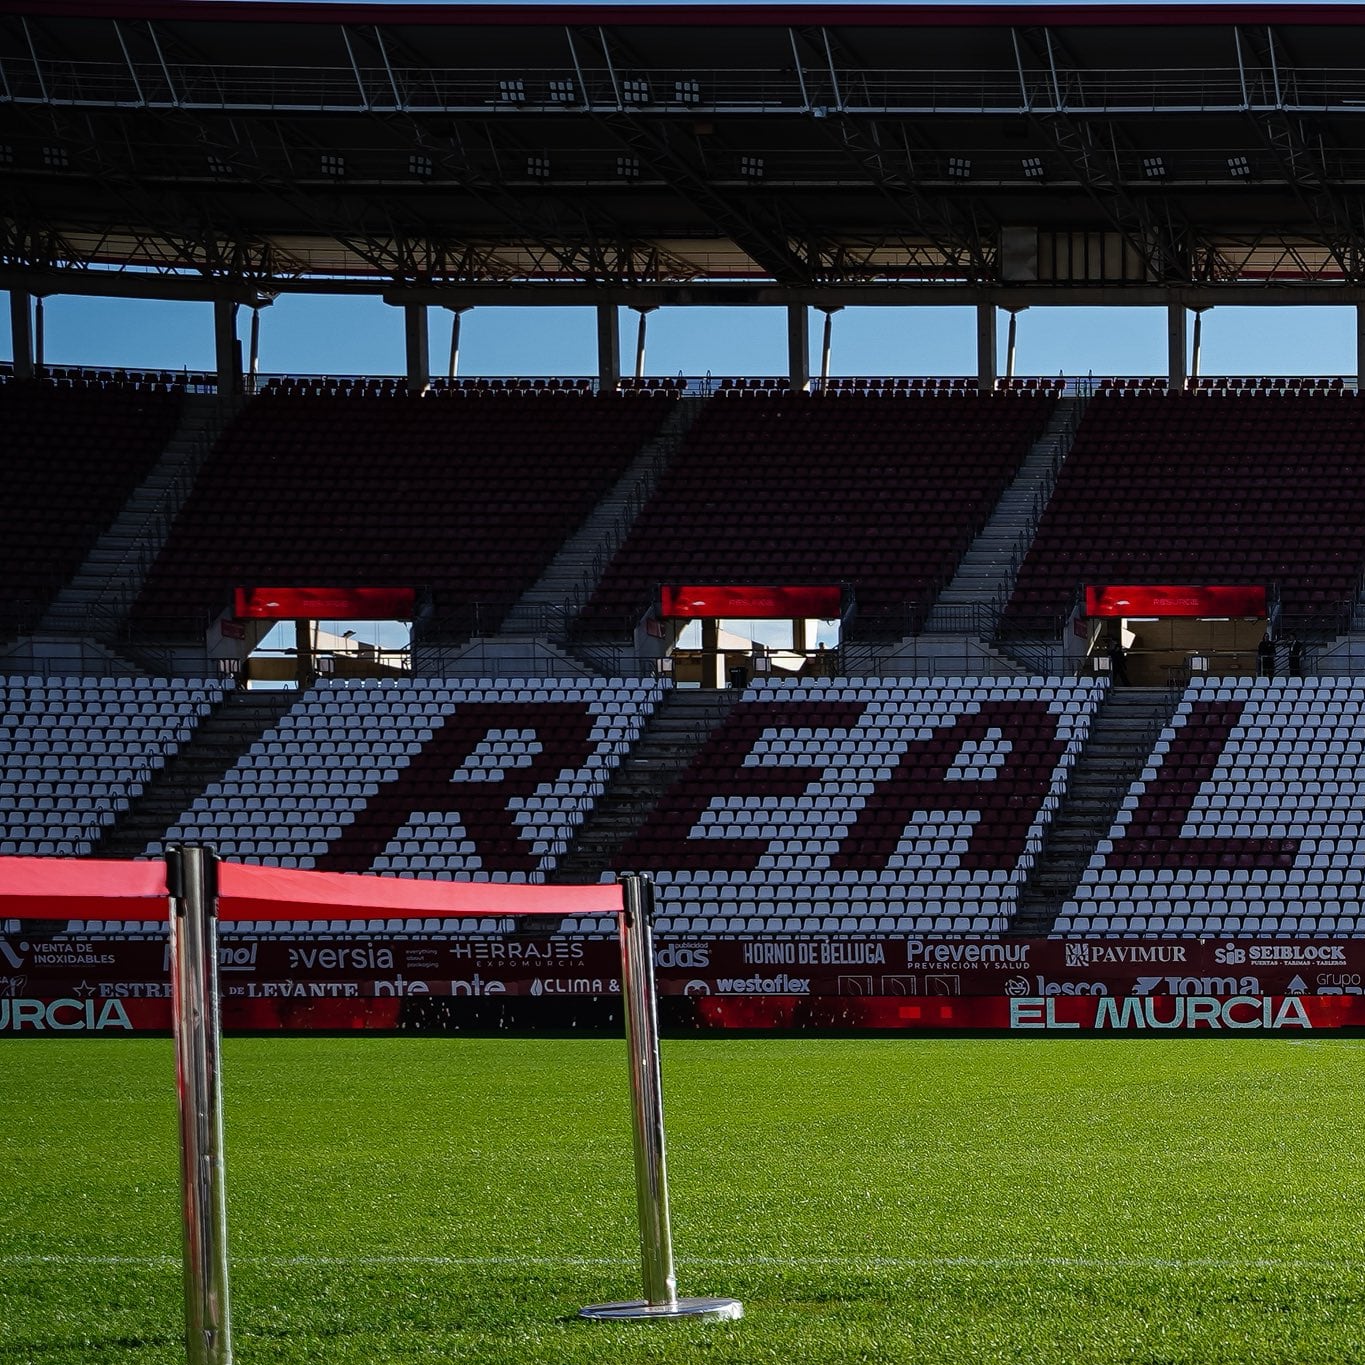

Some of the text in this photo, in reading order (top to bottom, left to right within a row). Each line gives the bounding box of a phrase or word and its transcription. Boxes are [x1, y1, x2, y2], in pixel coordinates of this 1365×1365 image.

[310, 699, 1297, 873] REAL
[33, 943, 94, 952] VENTA DE
[289, 942, 394, 969] eversia
[450, 943, 584, 959] HERRAJES
[744, 942, 886, 965] HORNO DE BELLUGA
[907, 940, 1030, 962] Prevemur
[1092, 946, 1187, 962] PAVIMUR
[1248, 946, 1346, 960] SEIBLOCK
[34, 955, 116, 964] INOXIDABLES
[907, 961, 1030, 970] PREVENCIÓN Y SALUD
[229, 987, 246, 996] DE
[247, 980, 359, 998] LEVANTE
[544, 979, 620, 993] CLIMA &
[716, 974, 811, 993] westaflex
[1036, 975, 1107, 996] lesco
[1316, 973, 1362, 987] Grupo
[0, 998, 134, 1030] RCIA
[1010, 996, 1313, 1029] EL MURCIA
